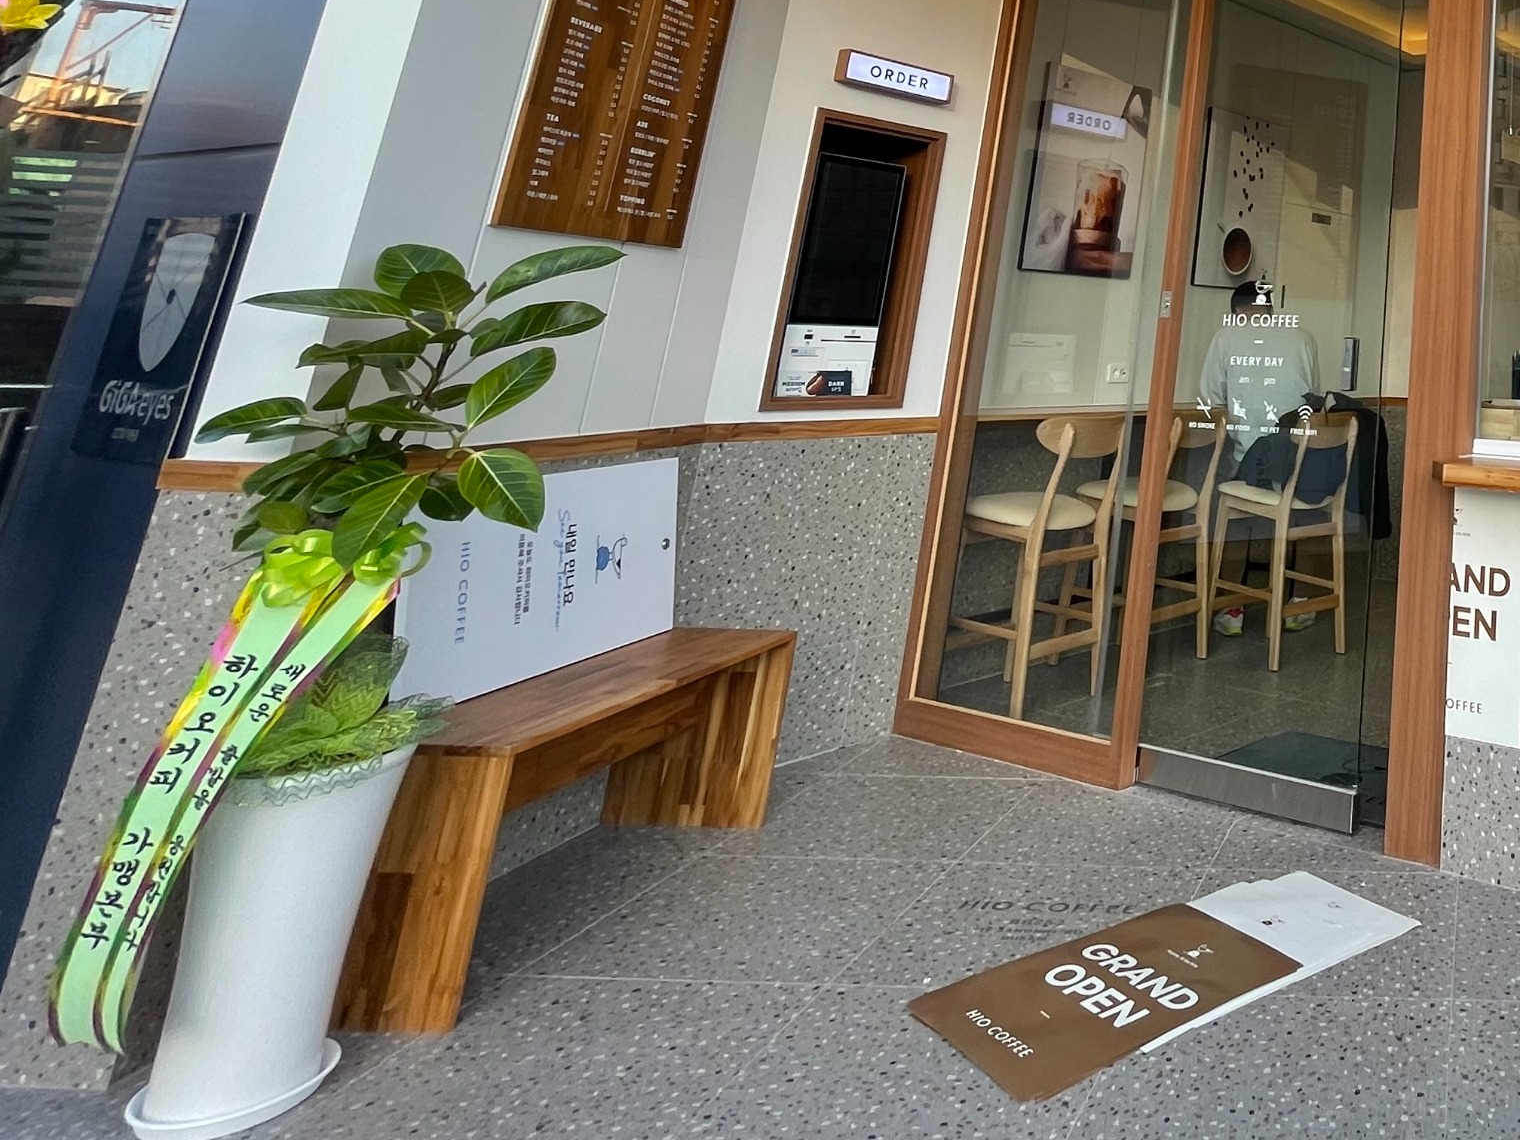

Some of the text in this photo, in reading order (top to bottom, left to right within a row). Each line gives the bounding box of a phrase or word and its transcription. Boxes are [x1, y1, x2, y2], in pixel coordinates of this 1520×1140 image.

[869, 64, 929, 91] ORDER
[1222, 313, 1299, 328] HIO COFFEE
[1229, 355, 1284, 367] EVERY DAY
[453, 540, 472, 646] HIO COFFEE
[562, 523, 578, 607] 내일 만나요
[148, 654, 260, 796] 하이오커피
[248, 662, 308, 724] 새로운
[80, 826, 155, 951] 가맹본부
[1043, 963, 1151, 1029] OPEN
[1080, 942, 1200, 1011] GRAND
[965, 1008, 1035, 1059] HIO COFFEE
